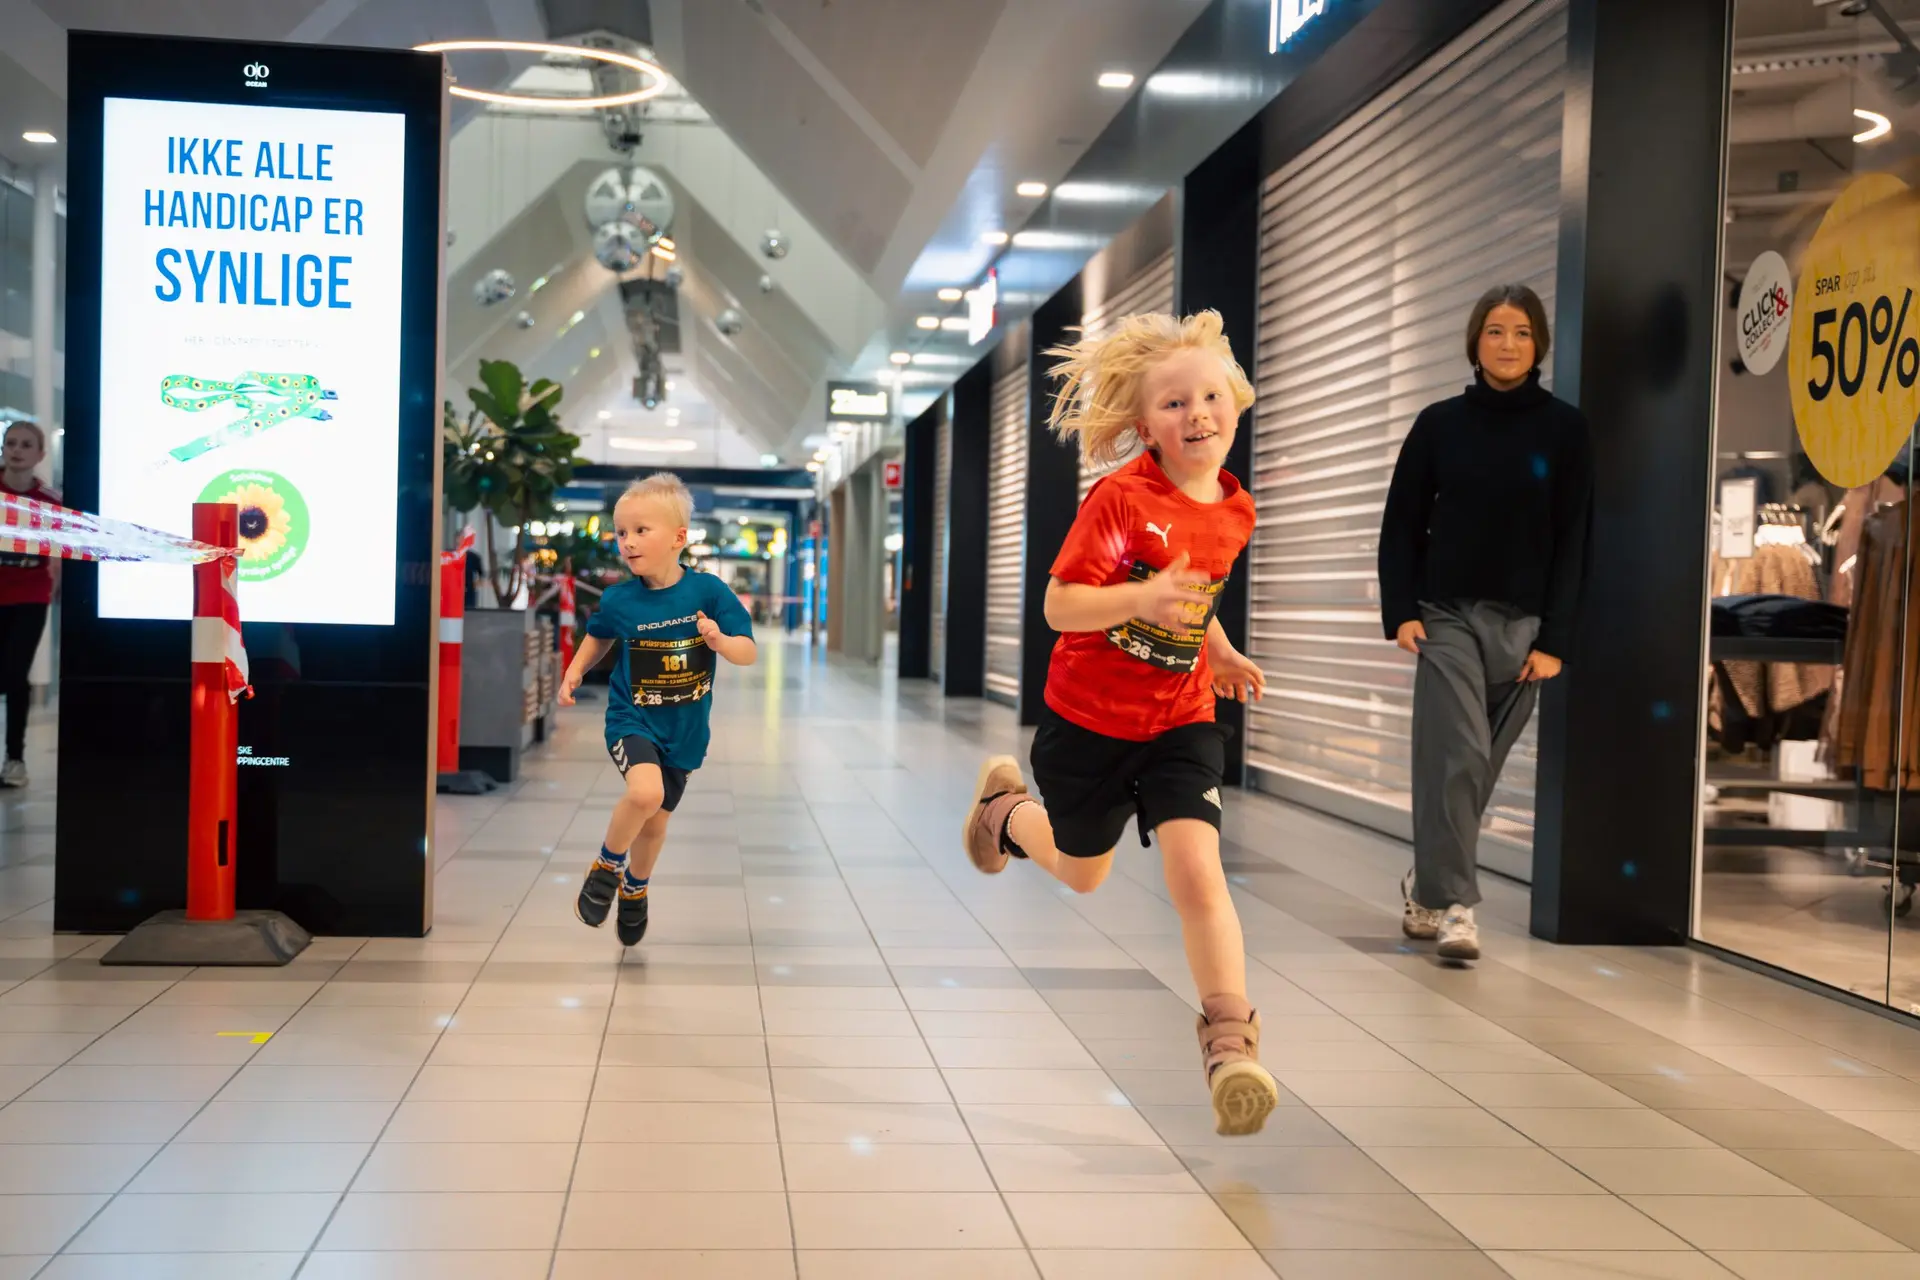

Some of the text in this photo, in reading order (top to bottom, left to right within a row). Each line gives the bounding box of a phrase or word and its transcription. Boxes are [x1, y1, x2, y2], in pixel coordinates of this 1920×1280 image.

[168, 136, 333, 181] IKKE ALLE
[145, 189, 364, 235] HANDICAP ER
[155, 247, 353, 308] SYNLIGE
[1815, 275, 1841, 296] SPAR
[1742, 281, 1777, 336] CLICK
[1775, 287, 1790, 317] &
[1745, 309, 1777, 350] COLLECT
[1807, 287, 1920, 402] 50%
[637, 614, 698, 631] ENDURANCE
[661, 653, 688, 672] 181
[236, 756, 290, 766] PPINGCENTRE
